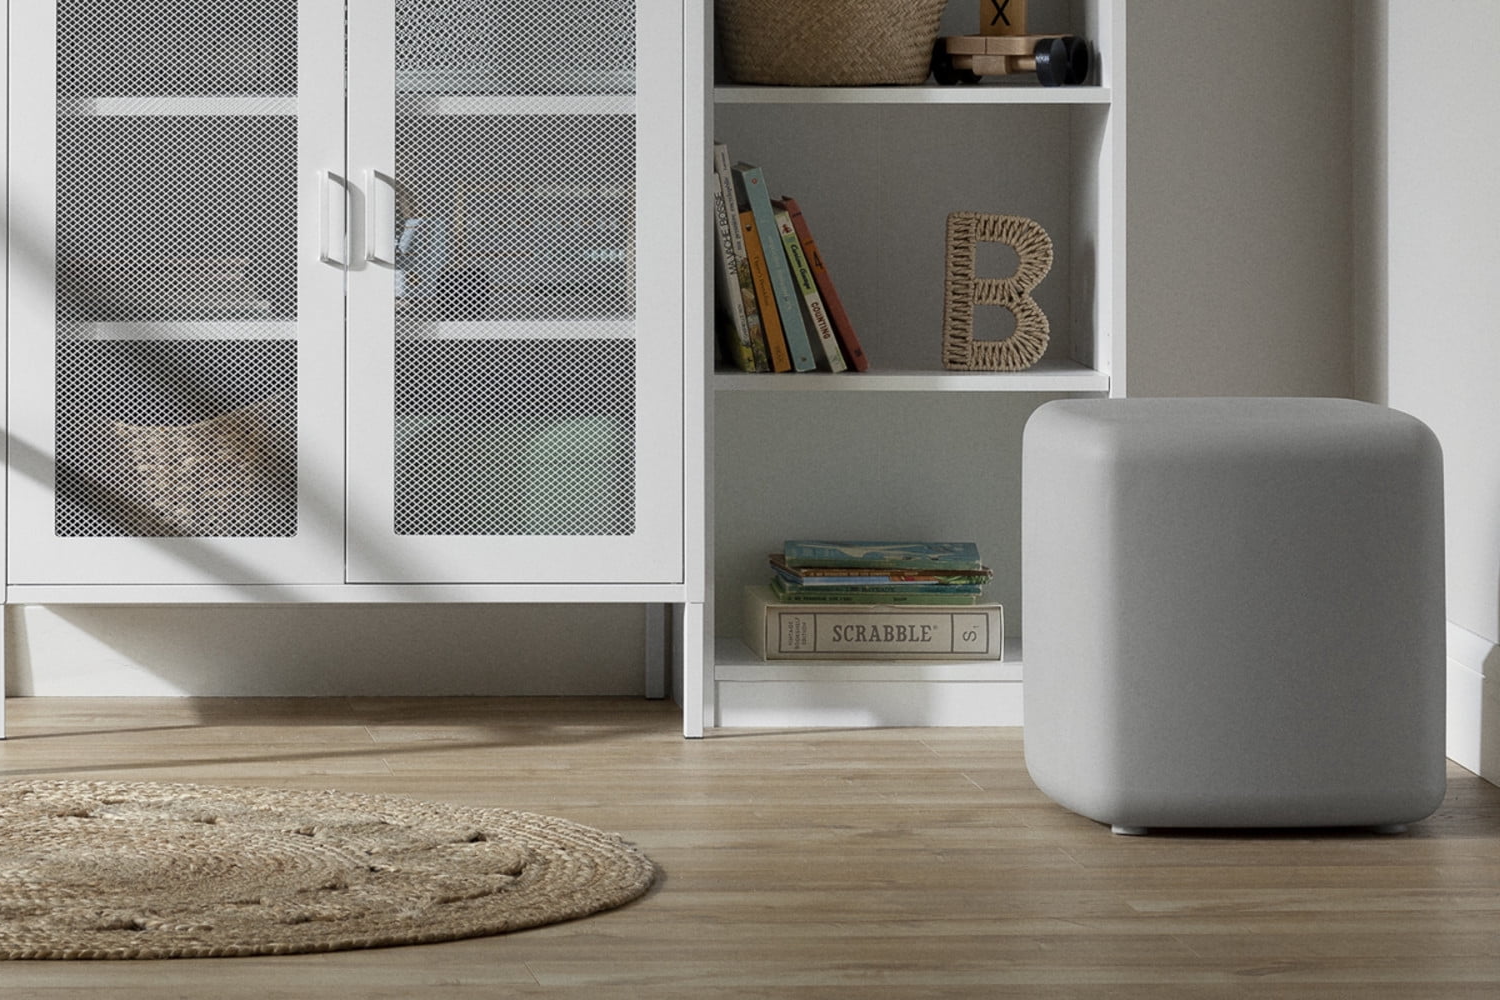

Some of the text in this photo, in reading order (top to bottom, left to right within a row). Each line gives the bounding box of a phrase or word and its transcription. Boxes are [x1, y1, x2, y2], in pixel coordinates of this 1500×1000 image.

[713, 191, 729, 226] BOSSE
[941, 211, 1054, 371] B
[810, 301, 831, 340] COUNTING
[832, 624, 933, 643] SCRABBLE
